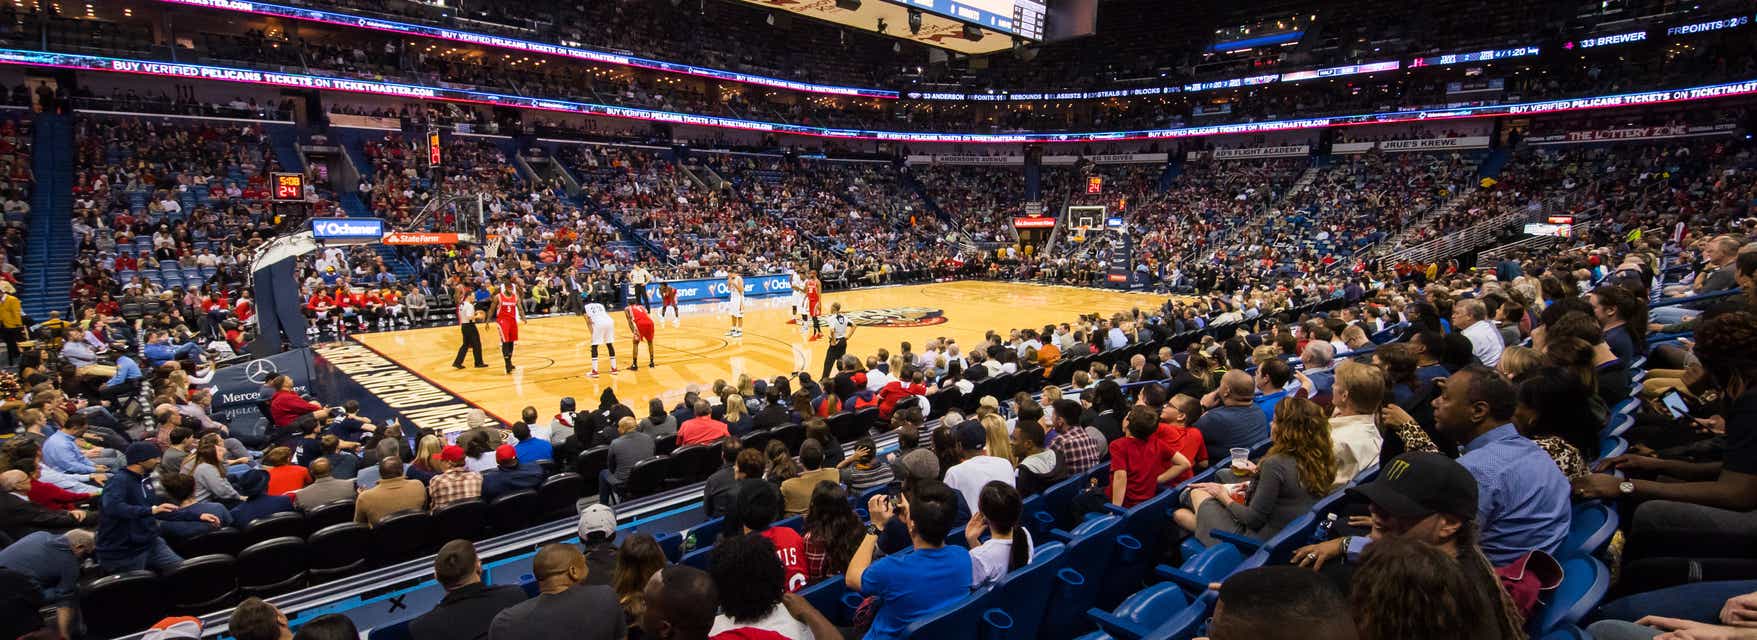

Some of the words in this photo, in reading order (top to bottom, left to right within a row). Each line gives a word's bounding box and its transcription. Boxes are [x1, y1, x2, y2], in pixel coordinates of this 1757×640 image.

[1582, 38, 1594, 48] 33
[1597, 31, 1647, 46] BREWER
[441, 31, 457, 39] BUY
[459, 34, 490, 43] VERIFIED
[492, 37, 526, 48] PELICANS
[528, 43, 556, 53] TICKETS
[557, 47, 566, 55] ON
[568, 49, 629, 64] TICKETMASTER.COM
[112, 60, 140, 71] BUY
[143, 63, 198, 76] VERIFIED
[200, 68, 261, 81] PELICANS
[264, 74, 312, 87] TICKETS
[315, 79, 329, 88] ON
[333, 80, 434, 97] TICKETMASTER.COM
[1134, 87, 1160, 95] BLOCKS
[1510, 104, 1529, 114] BUY
[1531, 101, 1570, 112] VERIFIED
[1571, 96, 1621, 109] PELICANS
[1625, 92, 1670, 105] TICKETS
[1674, 90, 1688, 100] ON
[606, 107, 620, 115] BUY
[622, 108, 650, 119] VERIFIED
[651, 111, 682, 122] PELICANS
[684, 115, 708, 125] TICKETS
[719, 118, 773, 131] TICKETMASTER.COM
[1148, 130, 1161, 138] BUY
[1162, 129, 1187, 137] VERIFIED
[1188, 127, 1218, 136] PELICANS
[1220, 125, 1247, 133] TICKETS
[1259, 120, 1330, 131] TICKETMASTER.COM
[1569, 131, 1593, 140] THE
[1595, 127, 1649, 139] LOTTERY
[1653, 125, 1686, 136] ZONE
[1235, 148, 1260, 156] FLIGHT
[1263, 146, 1303, 154] ACADEMY
[1384, 140, 1417, 149] JRUE'S
[1421, 138, 1456, 147] KREWE
[279, 186, 296, 197] 24
[1089, 184, 1100, 192] 24
[327, 222, 380, 235] Ochsner
